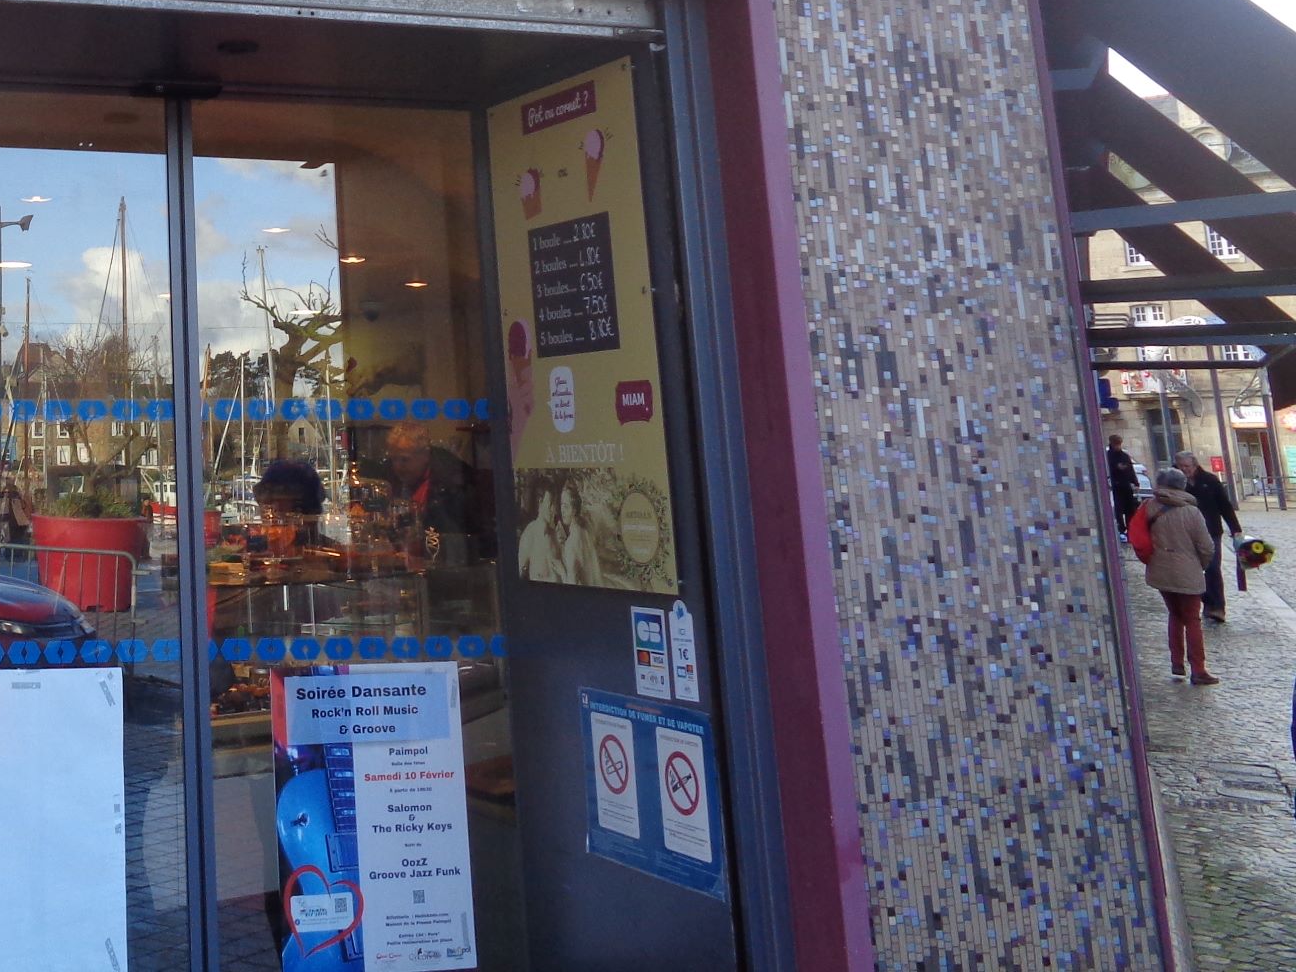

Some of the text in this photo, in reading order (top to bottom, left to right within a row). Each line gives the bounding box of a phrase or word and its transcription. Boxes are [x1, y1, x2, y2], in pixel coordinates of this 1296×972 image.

[539, 234, 561, 249] boule
[542, 257, 568, 273] boules
[547, 304, 572, 321] boules
[548, 329, 574, 345] boules
[622, 393, 645, 407] MIAM
[559, 439, 616, 463] BIENTÔT
[678, 647, 689, 662] 1€
[296, 683, 427, 701] Soirée Dansante
[311, 704, 419, 719] Rock'n Roll Music
[339, 724, 396, 735] & Groove
[389, 745, 429, 758] Paimpol
[364, 769, 455, 782] Samedi 10 Février
[387, 804, 432, 813] Salomon
[408, 813, 416, 821] &
[372, 822, 453, 834] The Ricky Keys
[369, 866, 461, 880] Groove Jazz Funk
